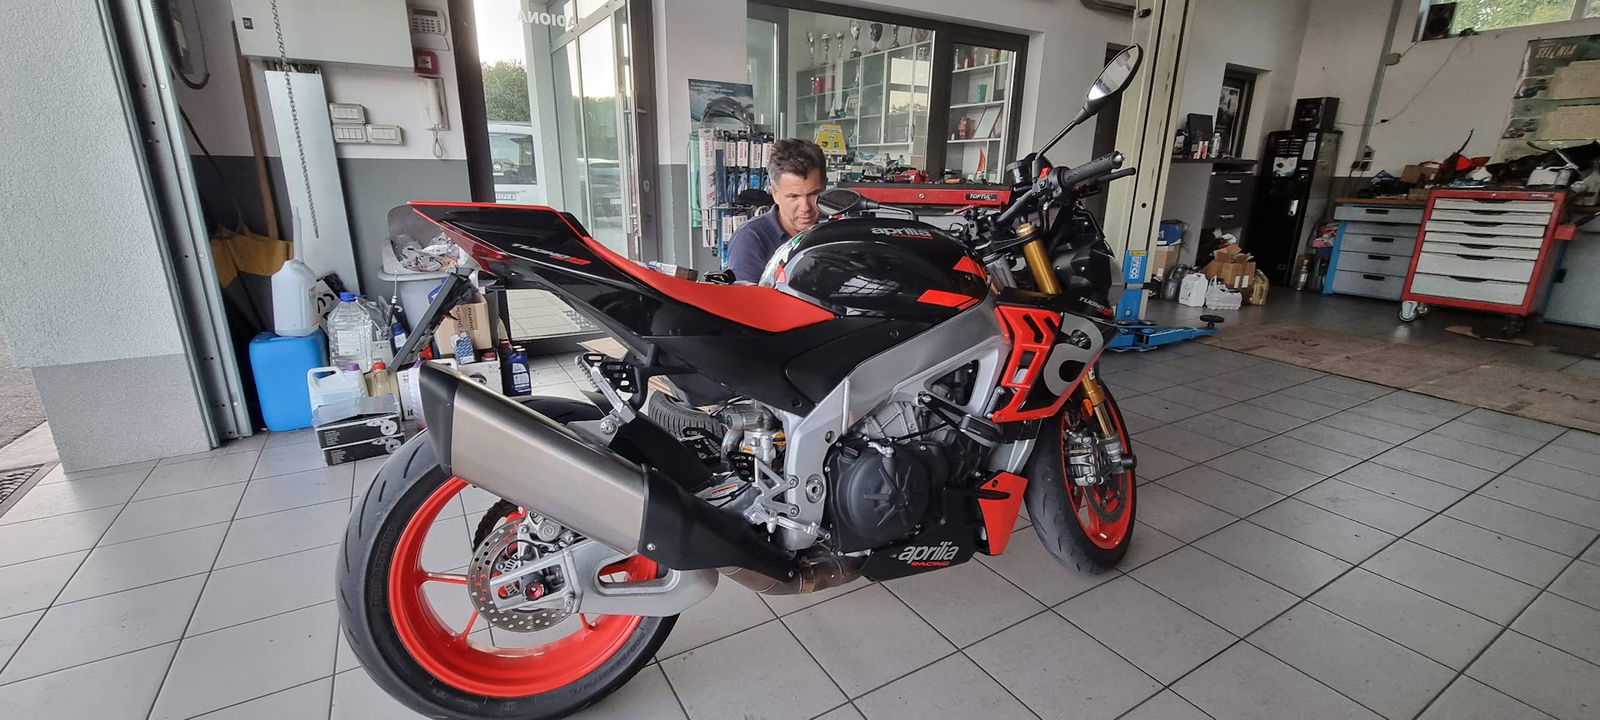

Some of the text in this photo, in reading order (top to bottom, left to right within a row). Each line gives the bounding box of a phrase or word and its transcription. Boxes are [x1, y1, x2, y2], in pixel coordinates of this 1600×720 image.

[871, 227, 932, 237] aprilia
[1080, 296, 1105, 310] TUONO
[898, 541, 960, 564] aprilia
